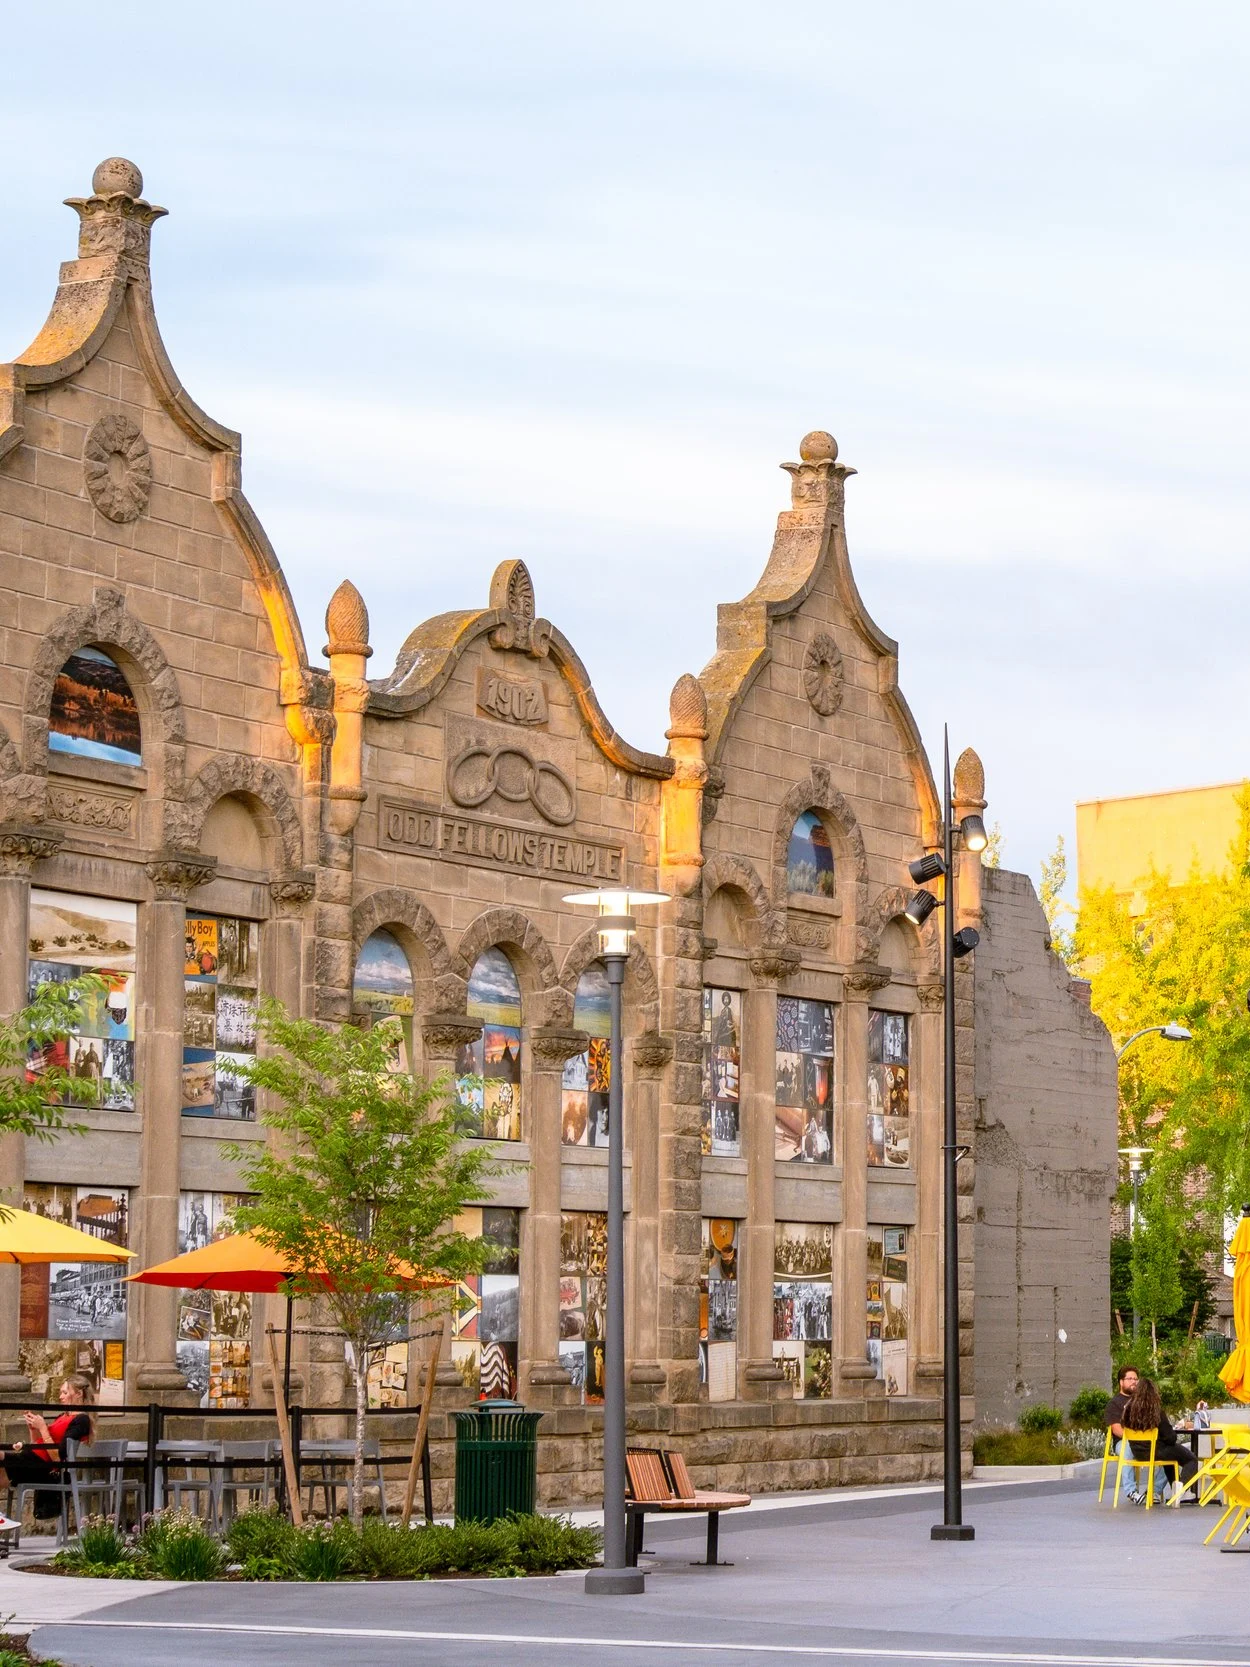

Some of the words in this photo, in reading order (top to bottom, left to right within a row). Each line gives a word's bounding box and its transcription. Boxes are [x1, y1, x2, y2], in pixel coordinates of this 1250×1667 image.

[486, 681, 542, 721] 1902
[388, 811, 436, 846] ODD
[438, 821, 538, 866] FELLOWS
[540, 840, 621, 879] TEMPLE
[197, 921, 213, 937] Boy
